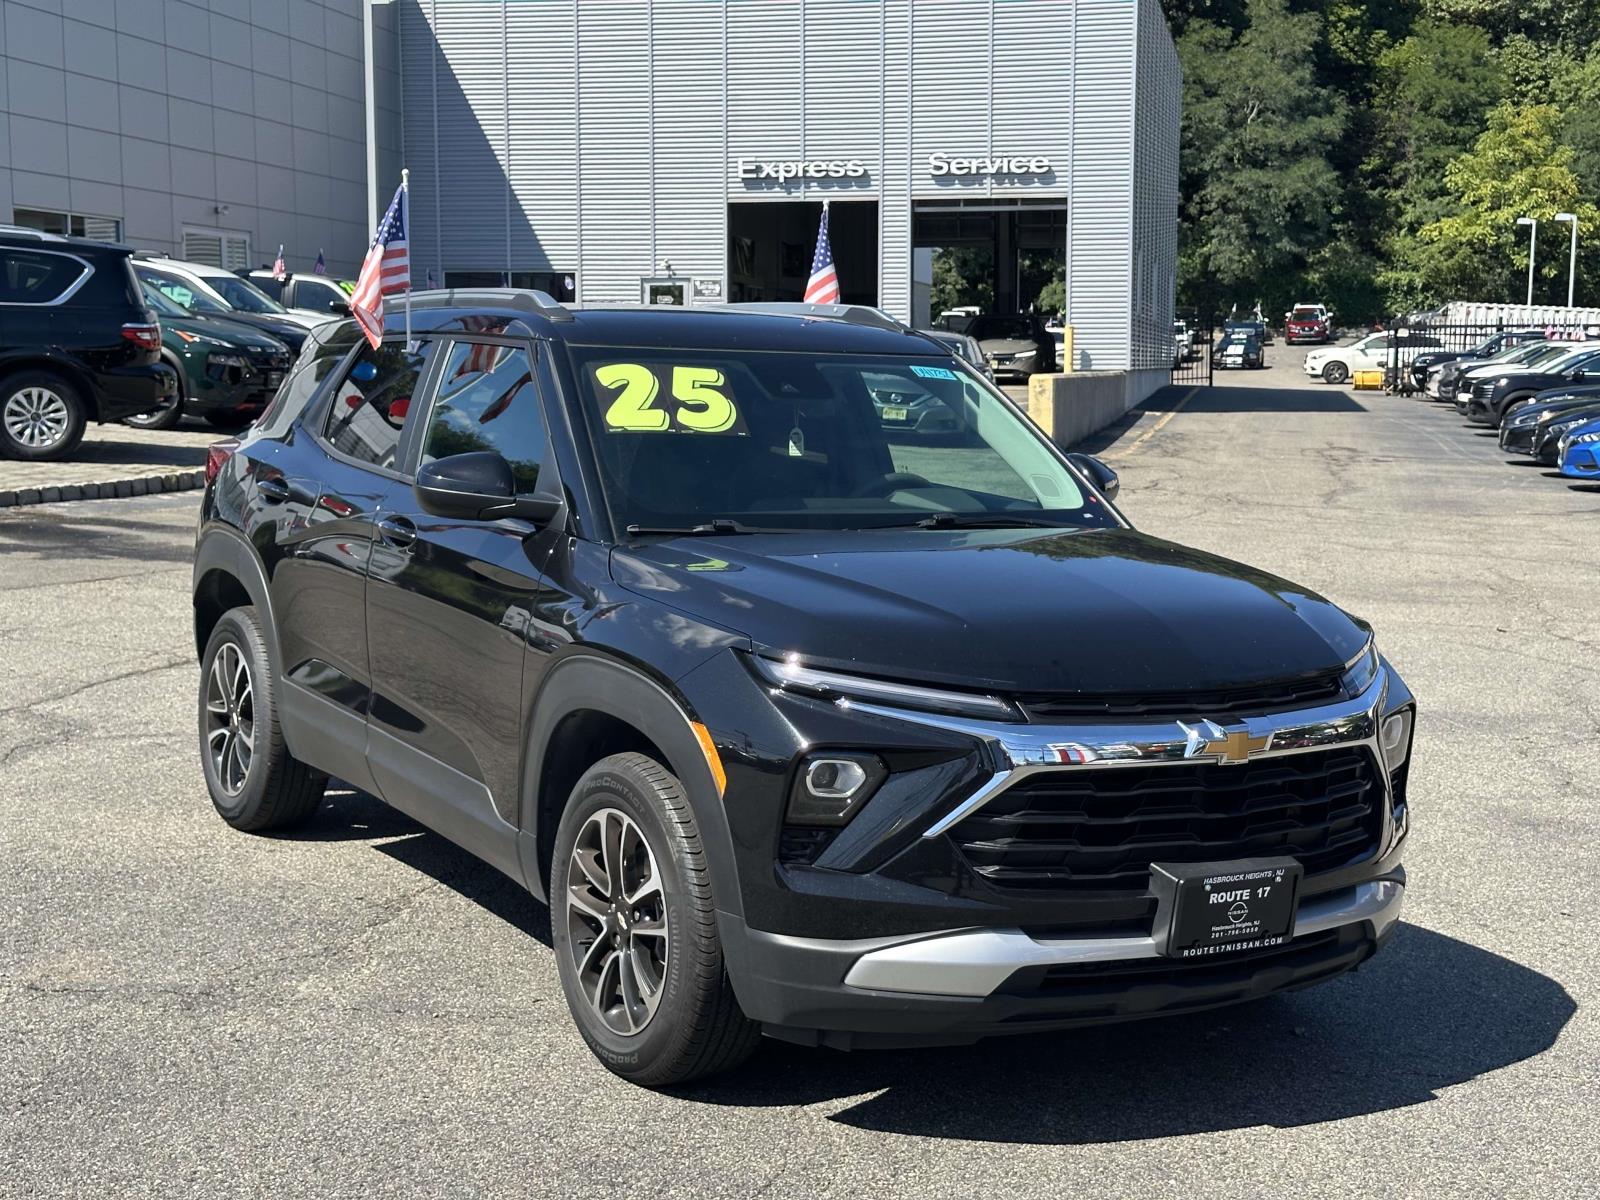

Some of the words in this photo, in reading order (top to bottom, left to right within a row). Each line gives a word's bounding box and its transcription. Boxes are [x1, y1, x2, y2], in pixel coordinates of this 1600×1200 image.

[737, 156, 865, 182] Express
[928, 152, 1050, 176] Service
[595, 363, 737, 433] 25
[1203, 874, 1244, 884] HASBROUCK
[1275, 868, 1285, 876] NJ
[1209, 889, 1251, 904] ROUTE
[1256, 886, 1271, 898] 17
[1183, 937, 1283, 956] ROUTE17NISSAN.COM
